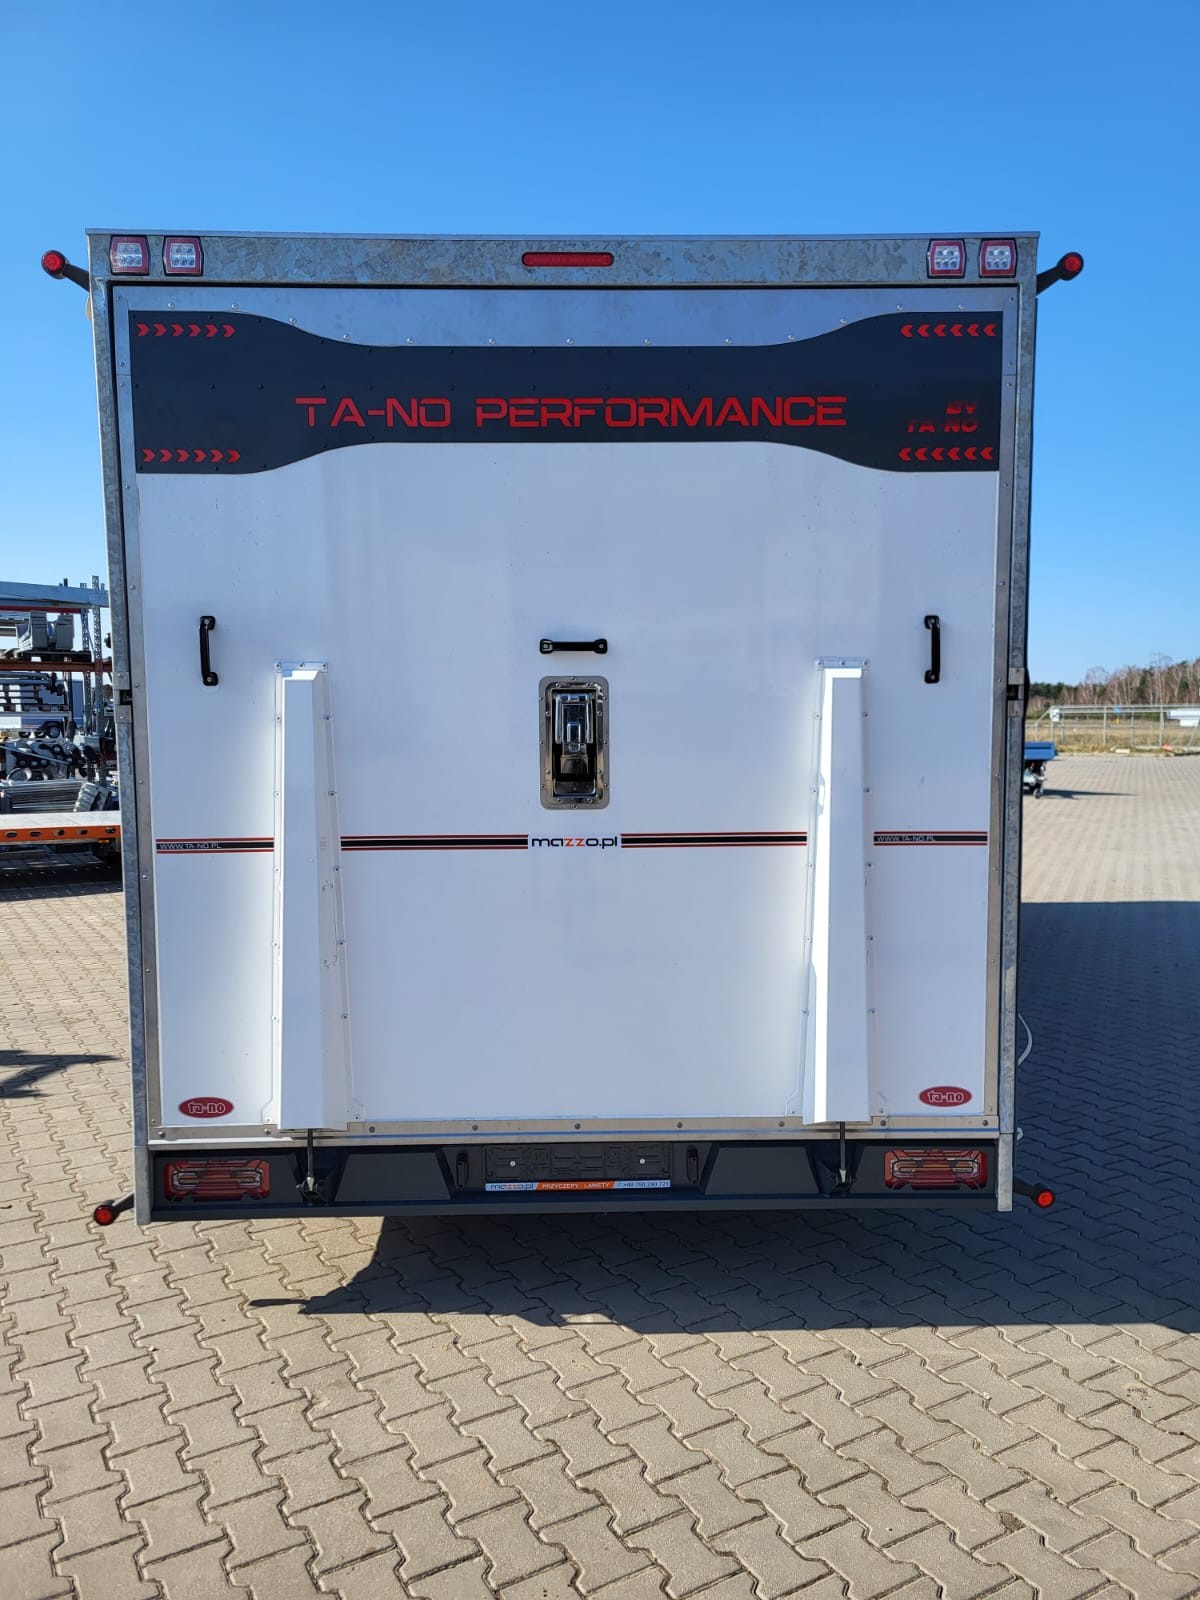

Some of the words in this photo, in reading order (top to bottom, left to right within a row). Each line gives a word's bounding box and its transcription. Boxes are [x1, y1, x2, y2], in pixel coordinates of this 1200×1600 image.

[295, 397, 451, 427] TA-NO
[475, 396, 847, 428] PERFORMANCE
[159, 842, 222, 850] WWW.TA-NO.PL
[531, 836, 618, 849] mazzo.pl
